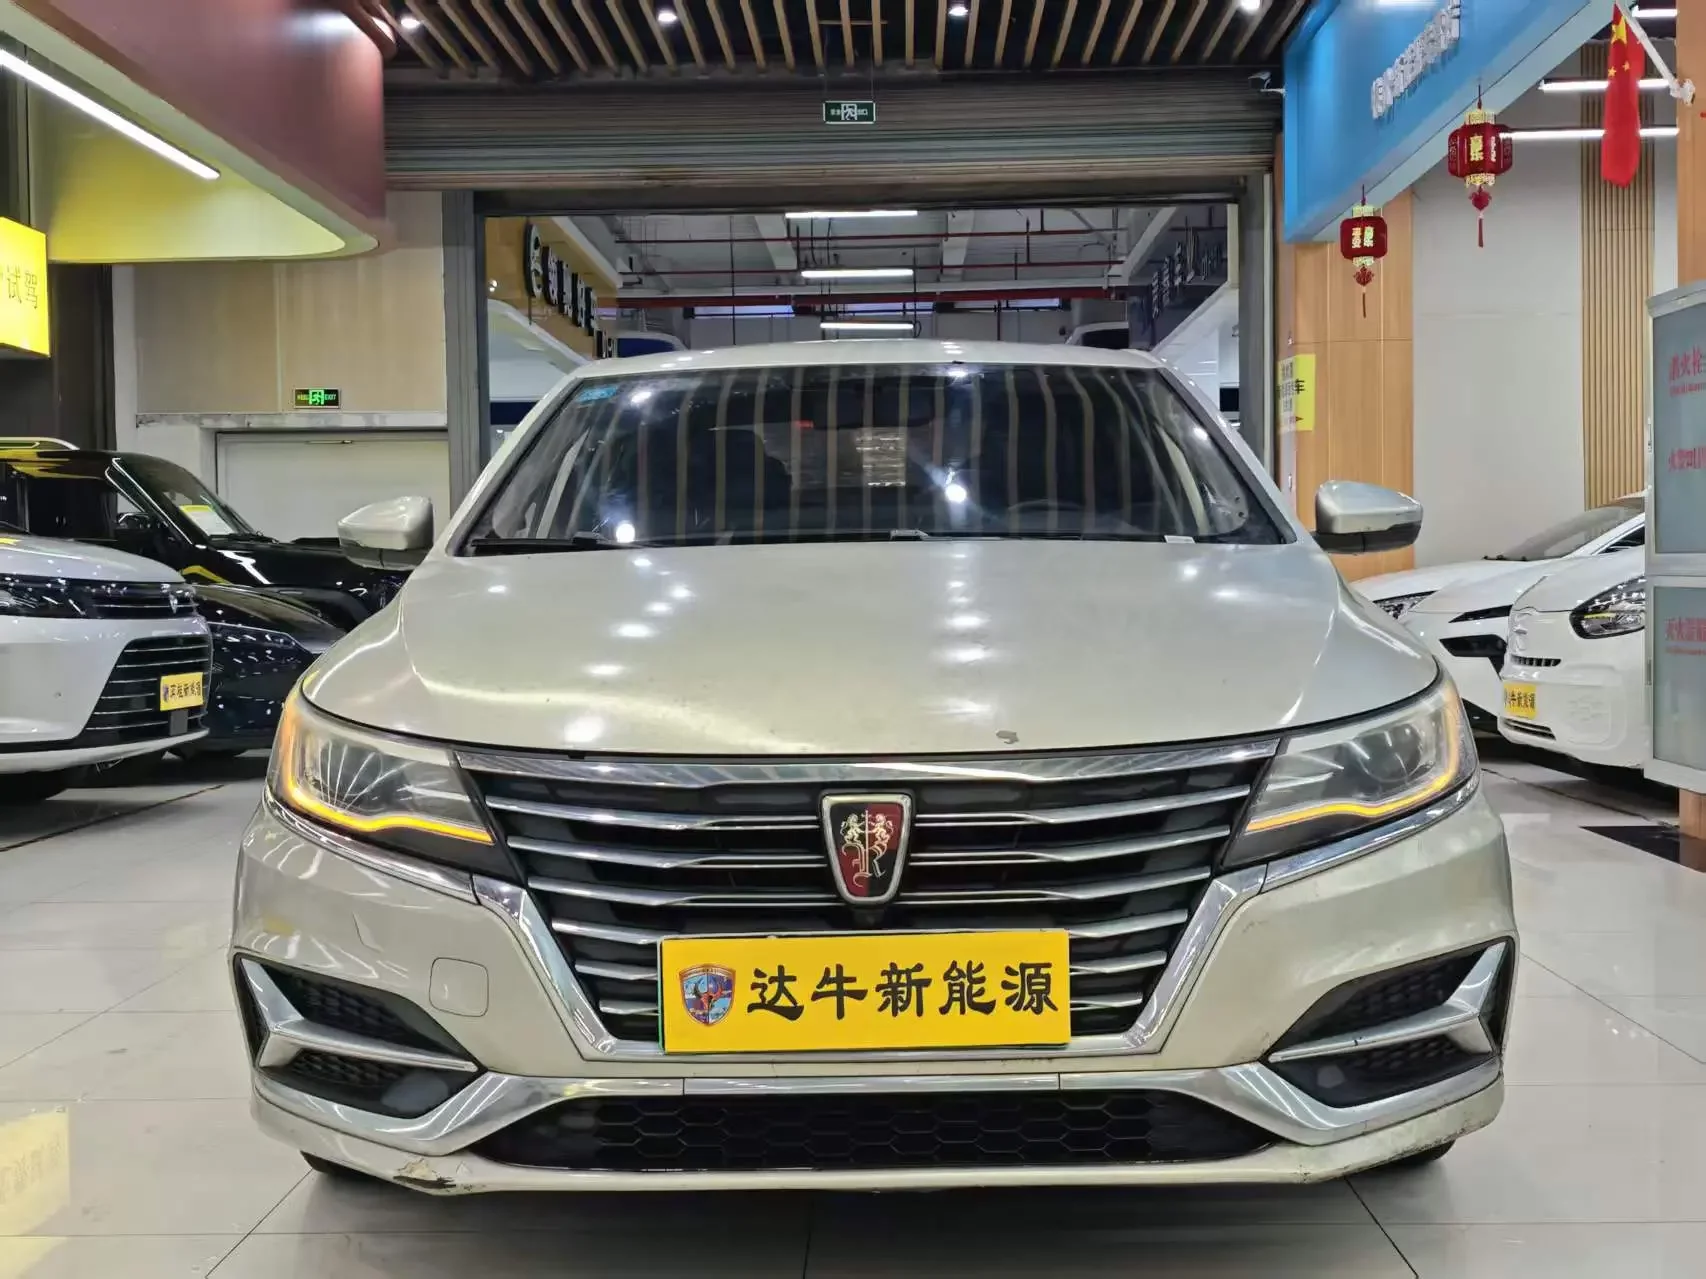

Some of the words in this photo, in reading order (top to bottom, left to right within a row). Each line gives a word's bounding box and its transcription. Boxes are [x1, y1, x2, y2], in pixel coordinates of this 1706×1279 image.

[0, 265, 38, 308] 试驾
[746, 959, 1059, 1022] 达牛新能源
